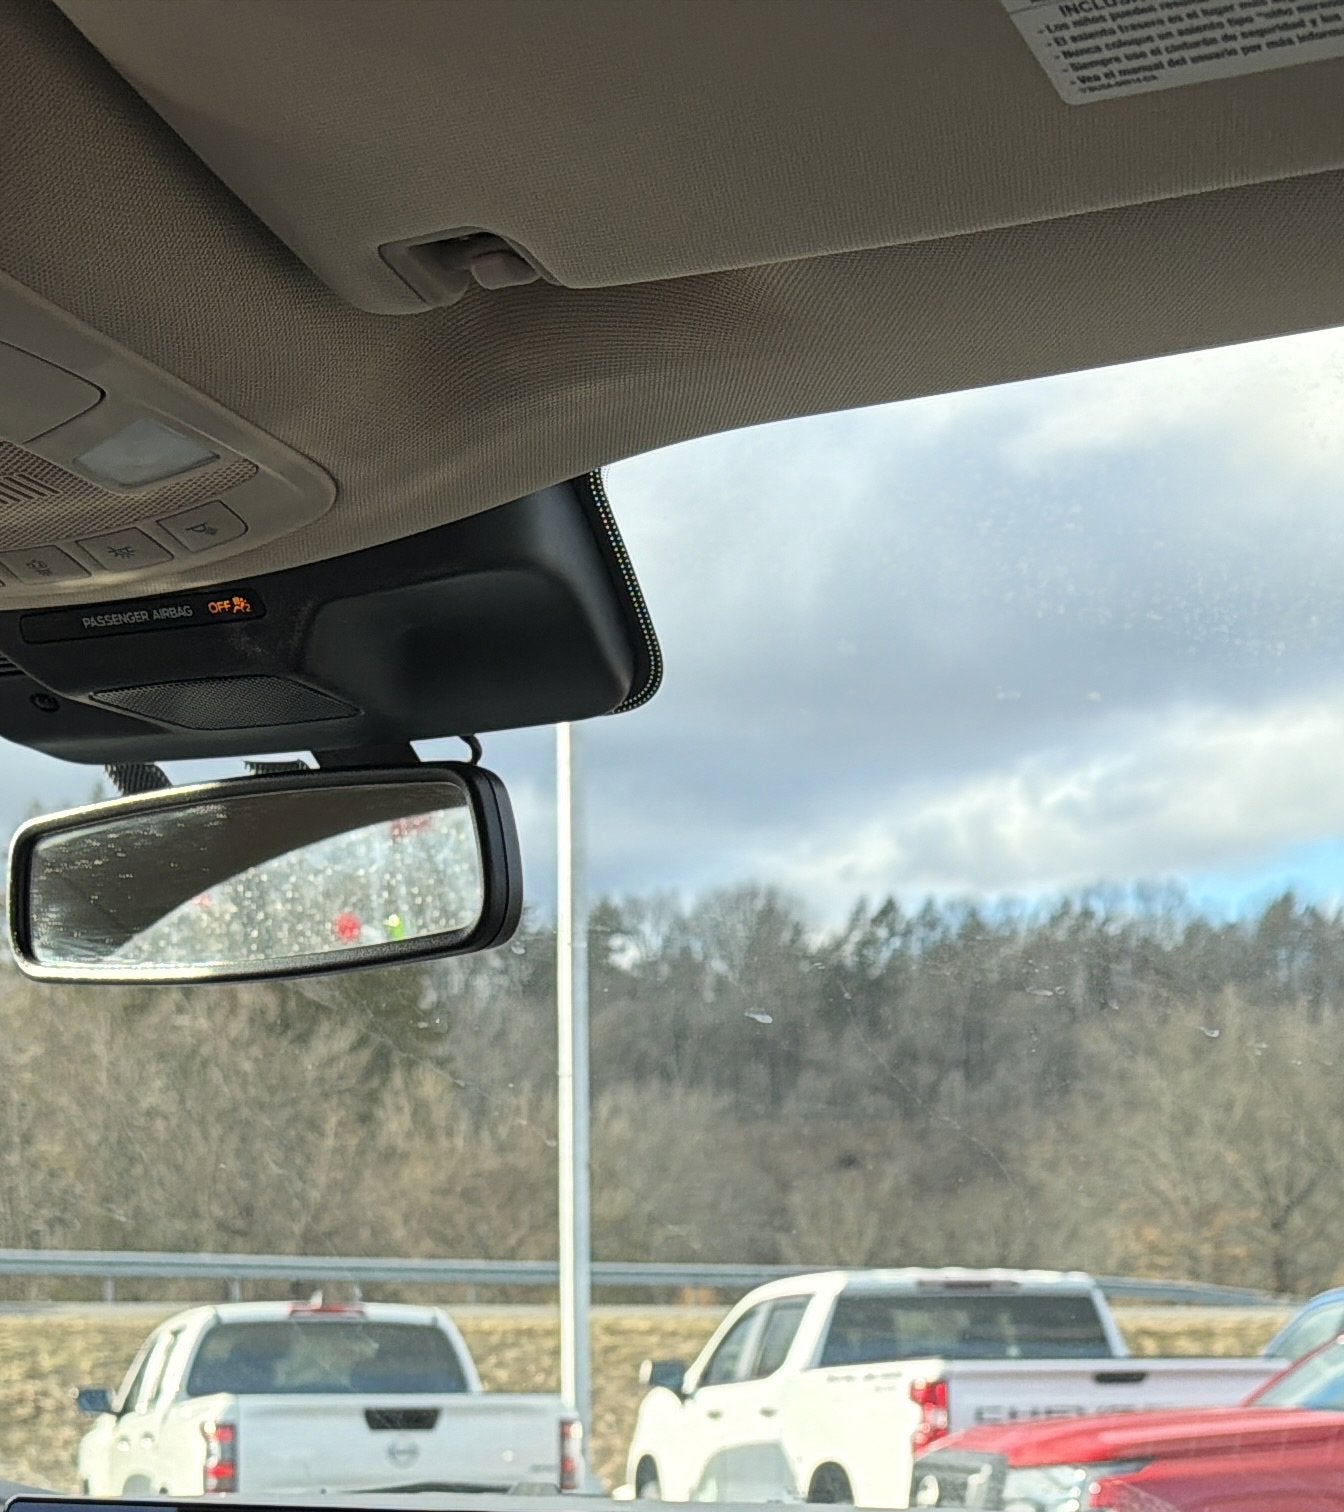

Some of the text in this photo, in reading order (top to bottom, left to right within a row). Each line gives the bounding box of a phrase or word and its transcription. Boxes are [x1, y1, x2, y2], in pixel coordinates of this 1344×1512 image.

[82, 605, 193, 629] PASSENGER AIRBAG
[208, 600, 231, 615] OFF
